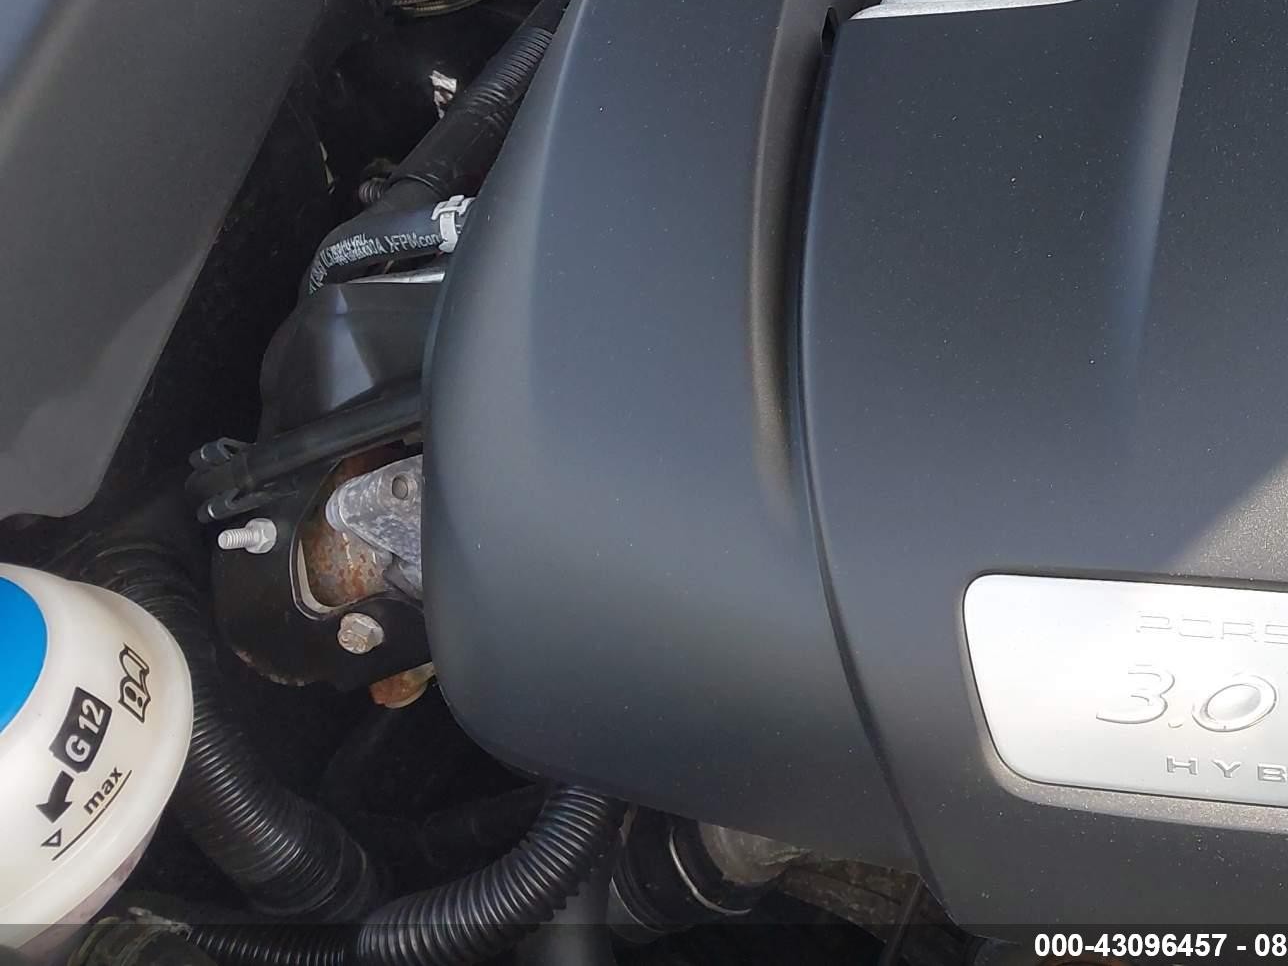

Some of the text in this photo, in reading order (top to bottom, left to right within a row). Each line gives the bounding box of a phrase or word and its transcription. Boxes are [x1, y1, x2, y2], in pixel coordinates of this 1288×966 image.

[1096, 664, 1278, 733] 3.0
[65, 699, 105, 763] G 12
[83, 767, 123, 815] max
